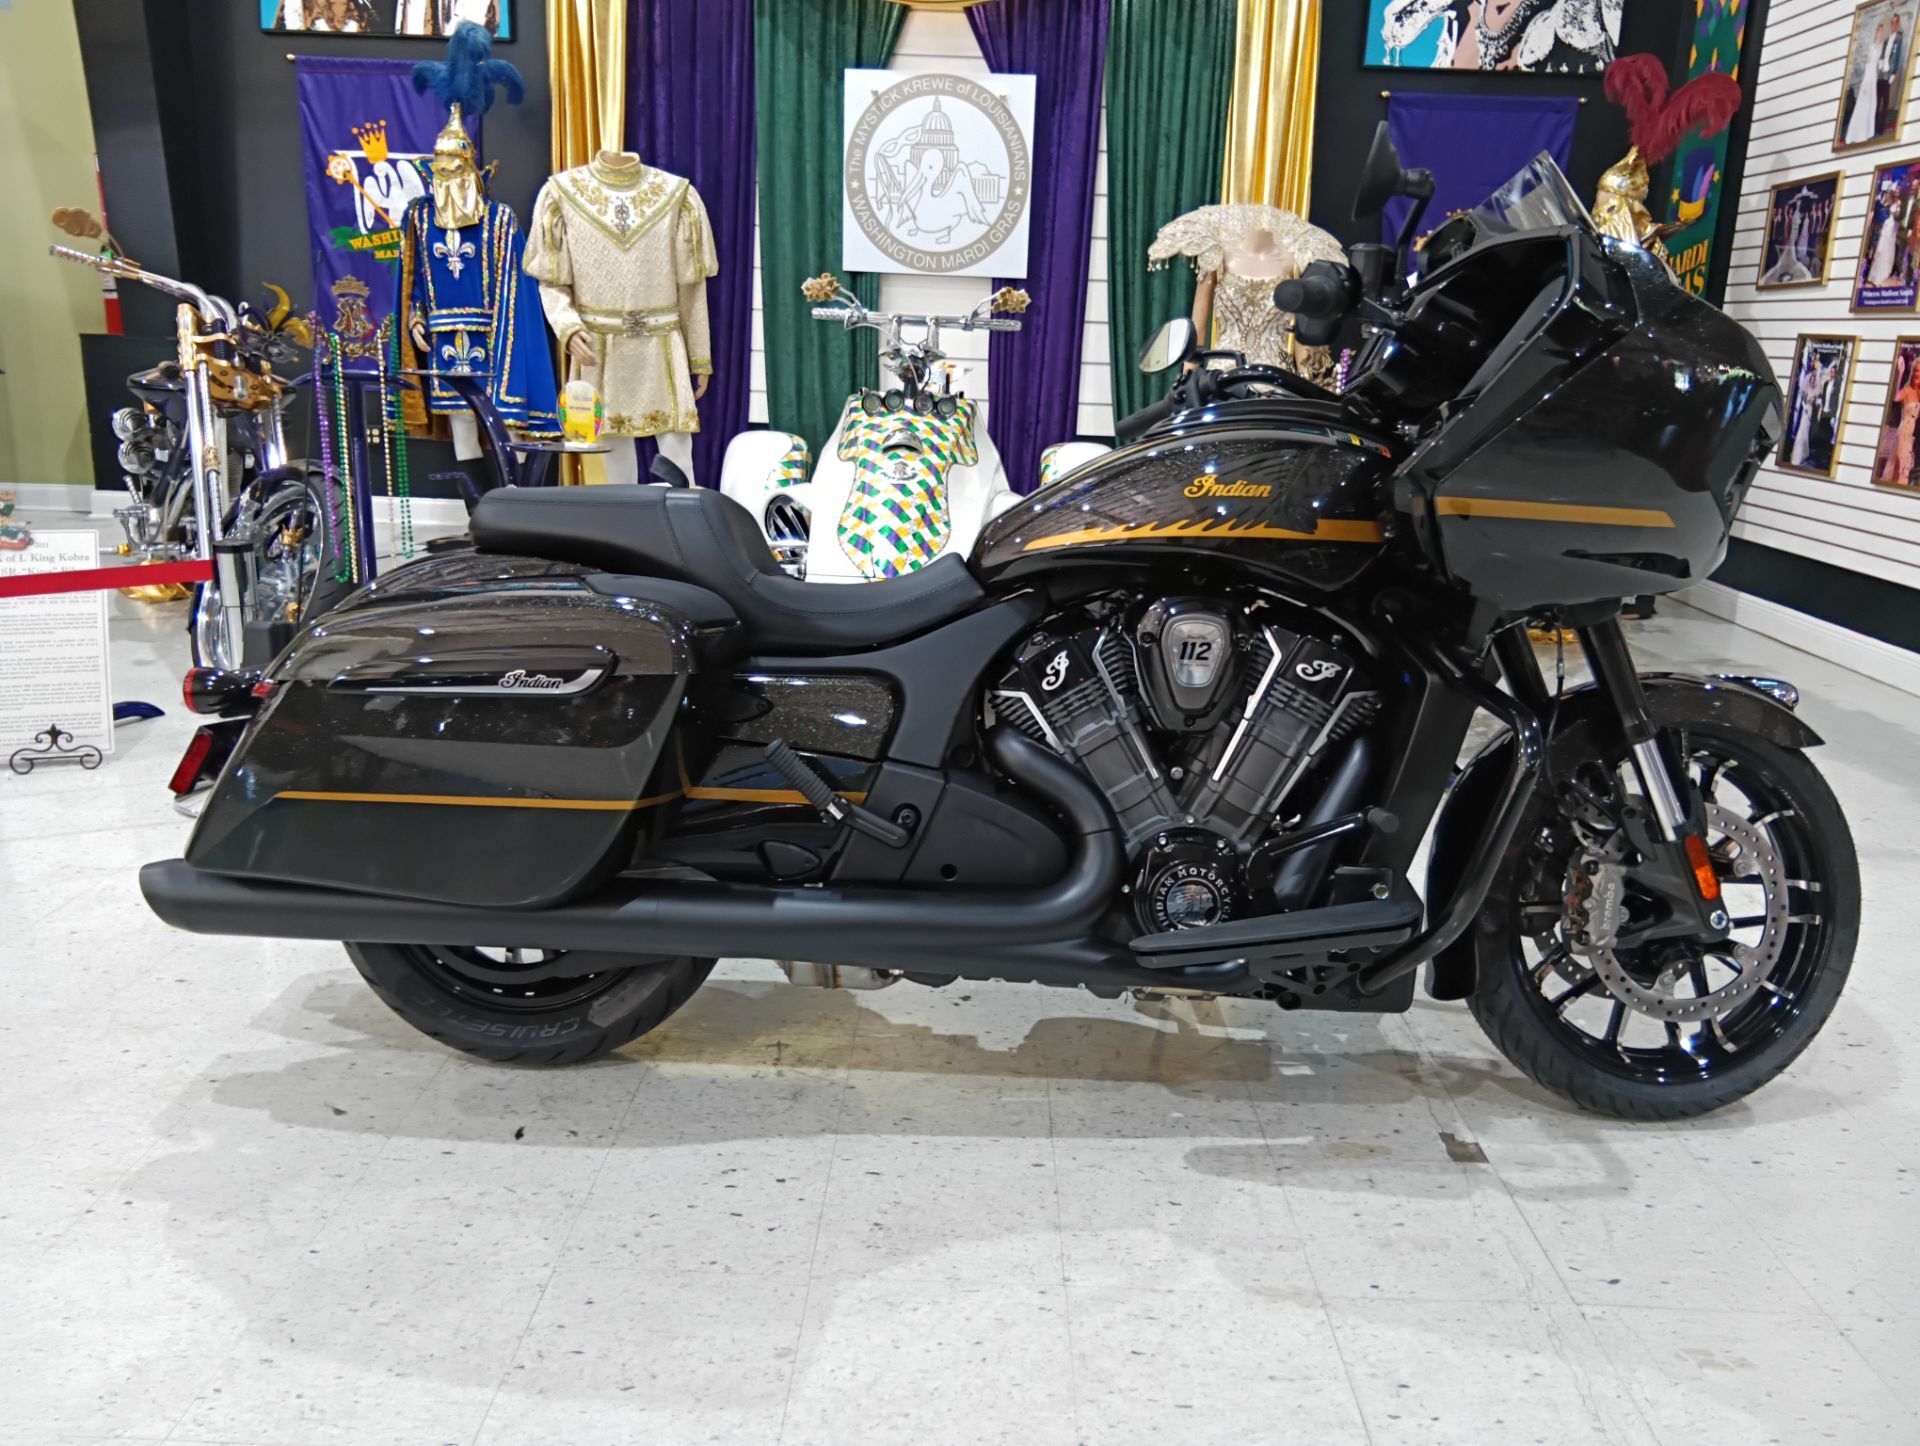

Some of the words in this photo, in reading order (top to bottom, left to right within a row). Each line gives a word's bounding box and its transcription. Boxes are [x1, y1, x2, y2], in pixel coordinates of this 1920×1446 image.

[902, 77, 954, 96] KREWE
[956, 82, 971, 95] of
[855, 89, 901, 145] MYSTICK
[971, 88, 1026, 181] LOUISIANIANS
[850, 148, 863, 173] The
[852, 193, 937, 269] WASHINGTON
[940, 241, 991, 269] MARDI
[989, 199, 1021, 244] GRAS
[1183, 474, 1272, 498] Indian
[6, 553, 16, 563] of
[31, 552, 56, 565] King
[59, 552, 90, 562] Kobra
[1180, 641, 1212, 661] 112
[499, 670, 563, 689] Indian
[1600, 882, 1616, 931] brembo
